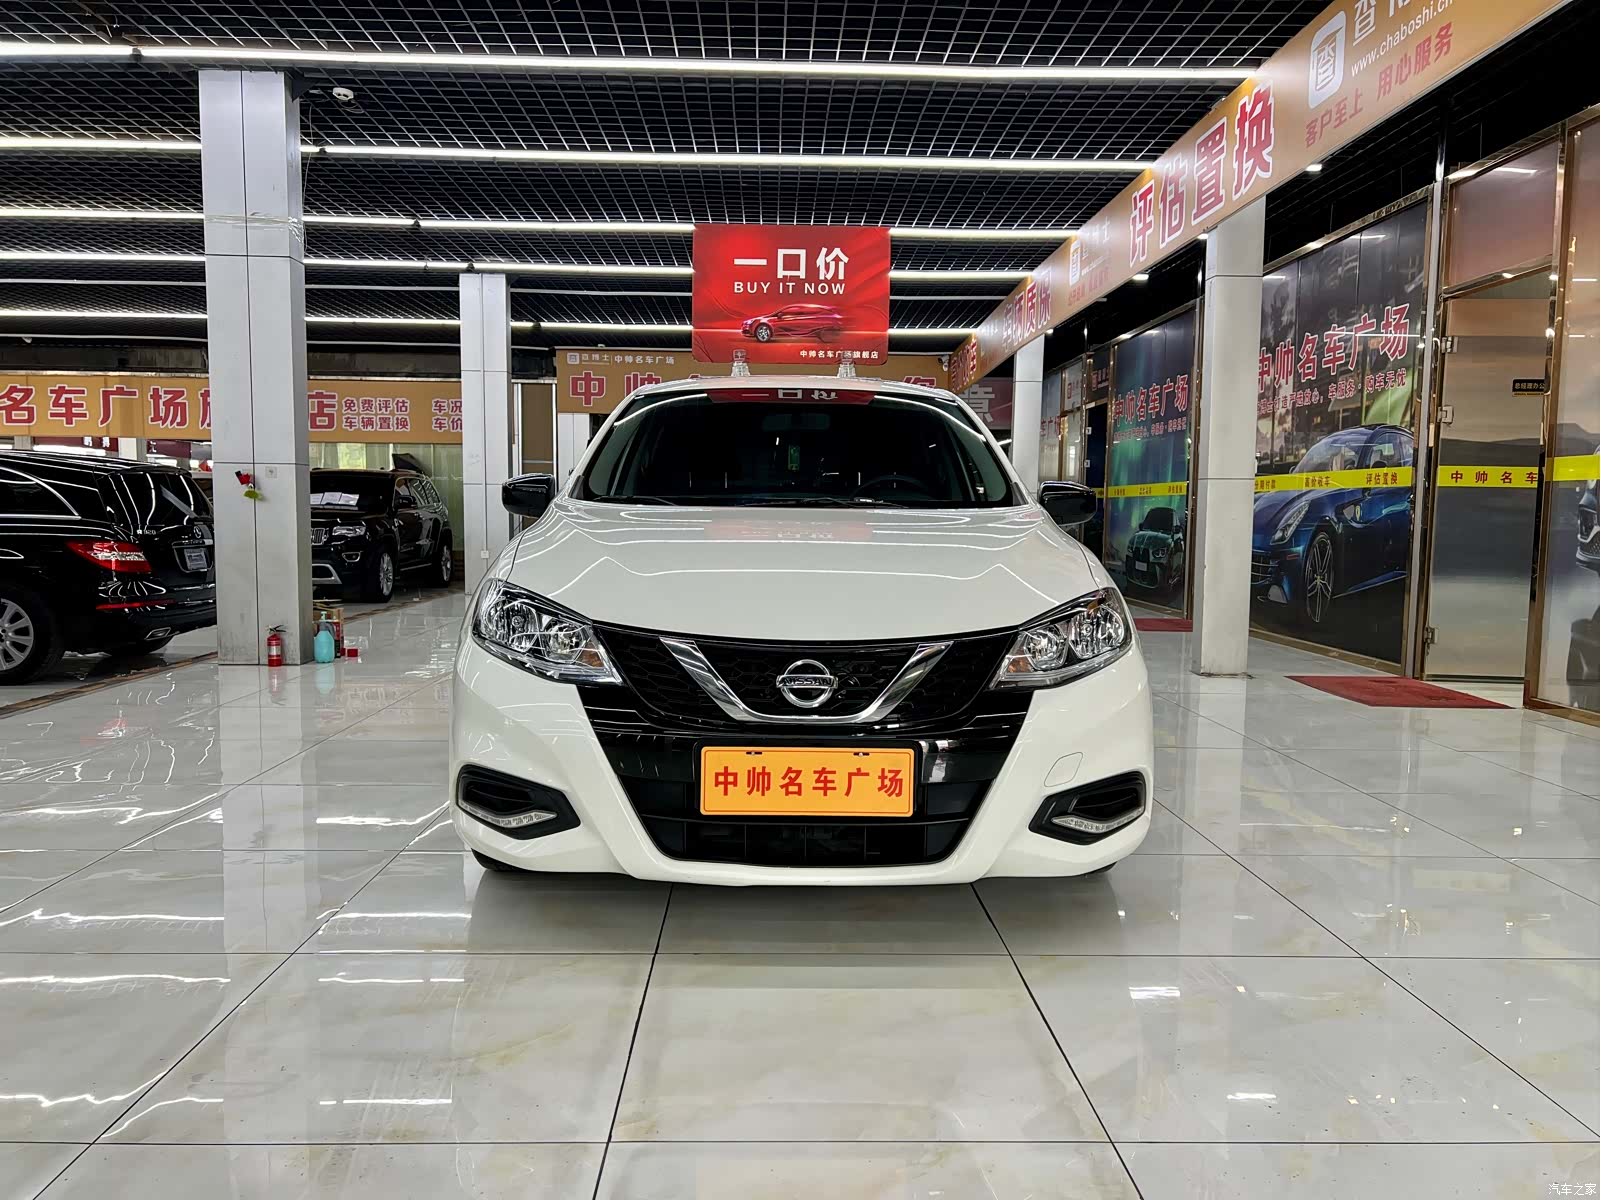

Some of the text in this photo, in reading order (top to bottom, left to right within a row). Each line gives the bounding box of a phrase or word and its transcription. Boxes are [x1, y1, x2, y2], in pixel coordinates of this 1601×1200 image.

[1353, 0, 1411, 46] 查
[1305, 22, 1453, 148] 客户至上 用心服务
[1130, 81, 1274, 268] 评估置换
[734, 247, 849, 280] 一口价
[734, 282, 846, 294] BUY IT NOW
[799, 350, 879, 359] 中帅名车广场旗舰店
[1258, 303, 1410, 393] 中帅名车广场
[614, 355, 675, 365] 中帅名车广场
[307, 390, 338, 431] 店
[342, 397, 462, 413] 免费评估 车况
[342, 415, 462, 431] 车辆置换 车价
[1366, 471, 1398, 485] 评估置换
[1450, 470, 1538, 485] 中帅名车
[781, 676, 833, 687] NISSAN
[713, 766, 904, 798] 中帅名车广场
